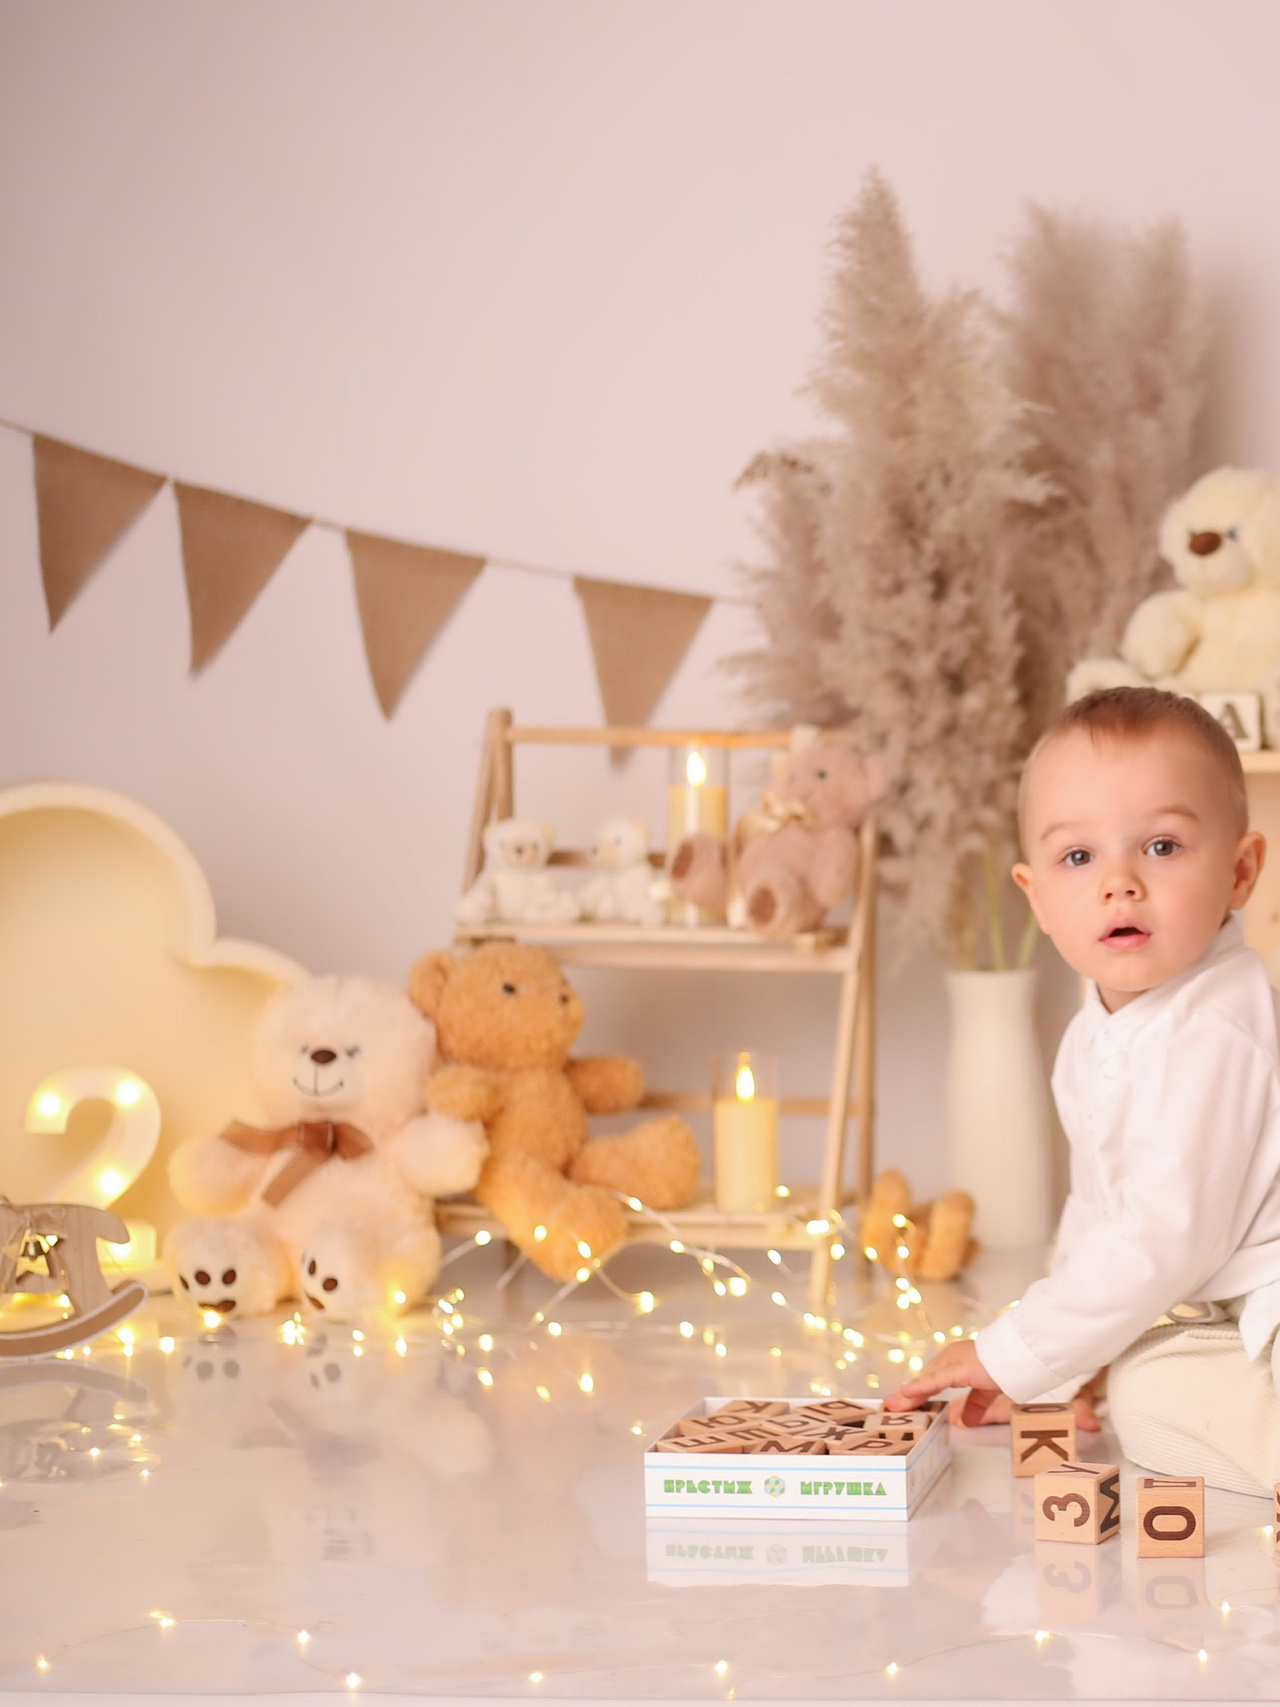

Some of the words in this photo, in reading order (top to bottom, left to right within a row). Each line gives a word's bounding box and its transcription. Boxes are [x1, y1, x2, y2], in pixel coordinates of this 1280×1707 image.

[1020, 1429, 1069, 1463] К
[663, 1479, 754, 1495] ПРЕСТИЖ
[800, 1481, 888, 1496] ИГРУШКА
